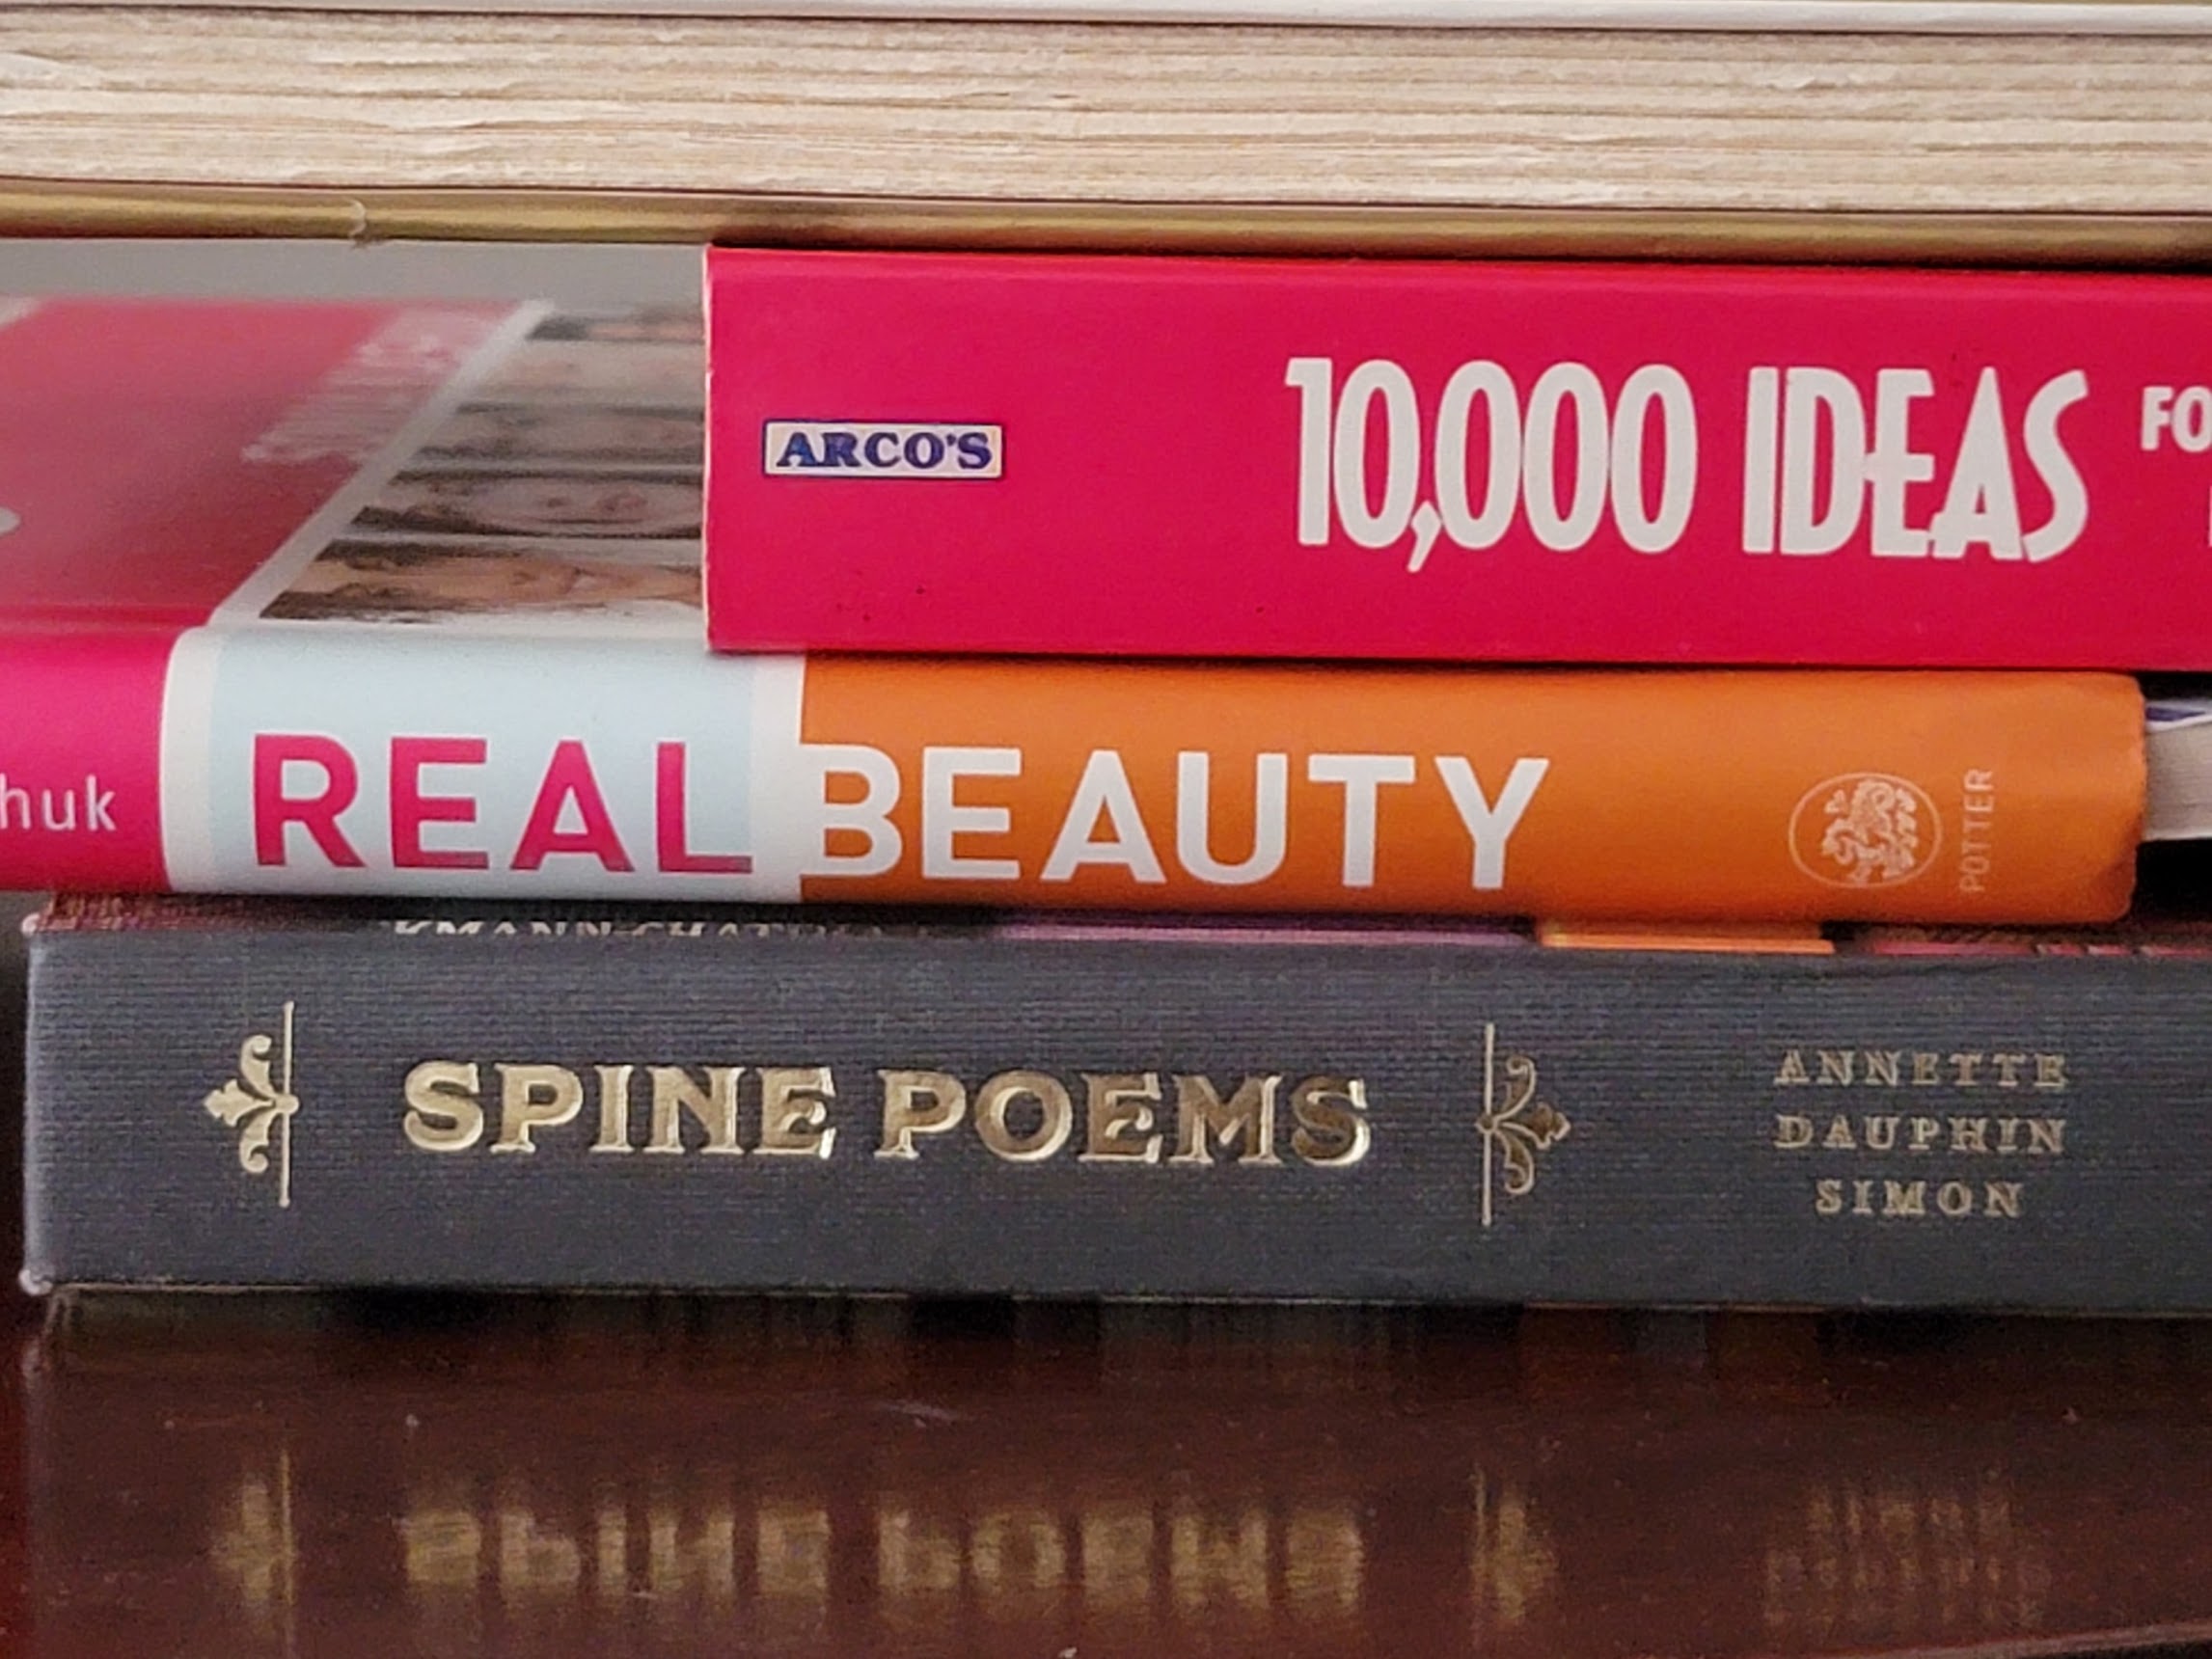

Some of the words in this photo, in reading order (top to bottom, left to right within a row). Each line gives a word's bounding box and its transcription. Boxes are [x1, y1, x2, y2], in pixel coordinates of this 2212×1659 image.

[777, 431, 993, 470] ARCO'S
[1285, 358, 1698, 573] 10,000
[1743, 367, 2088, 563] IDEAS
[254, 734, 752, 873] REAL
[803, 744, 1549, 889] BEAUTY
[1959, 768, 1995, 893] POTTER
[1773, 1048, 2070, 1088] ANNETTE
[403, 1060, 836, 1158] SPINE
[874, 1069, 1372, 1168] POEMS
[1774, 1114, 2067, 1154] DAUPHIN
[1815, 1178, 2024, 1218] SIMON
